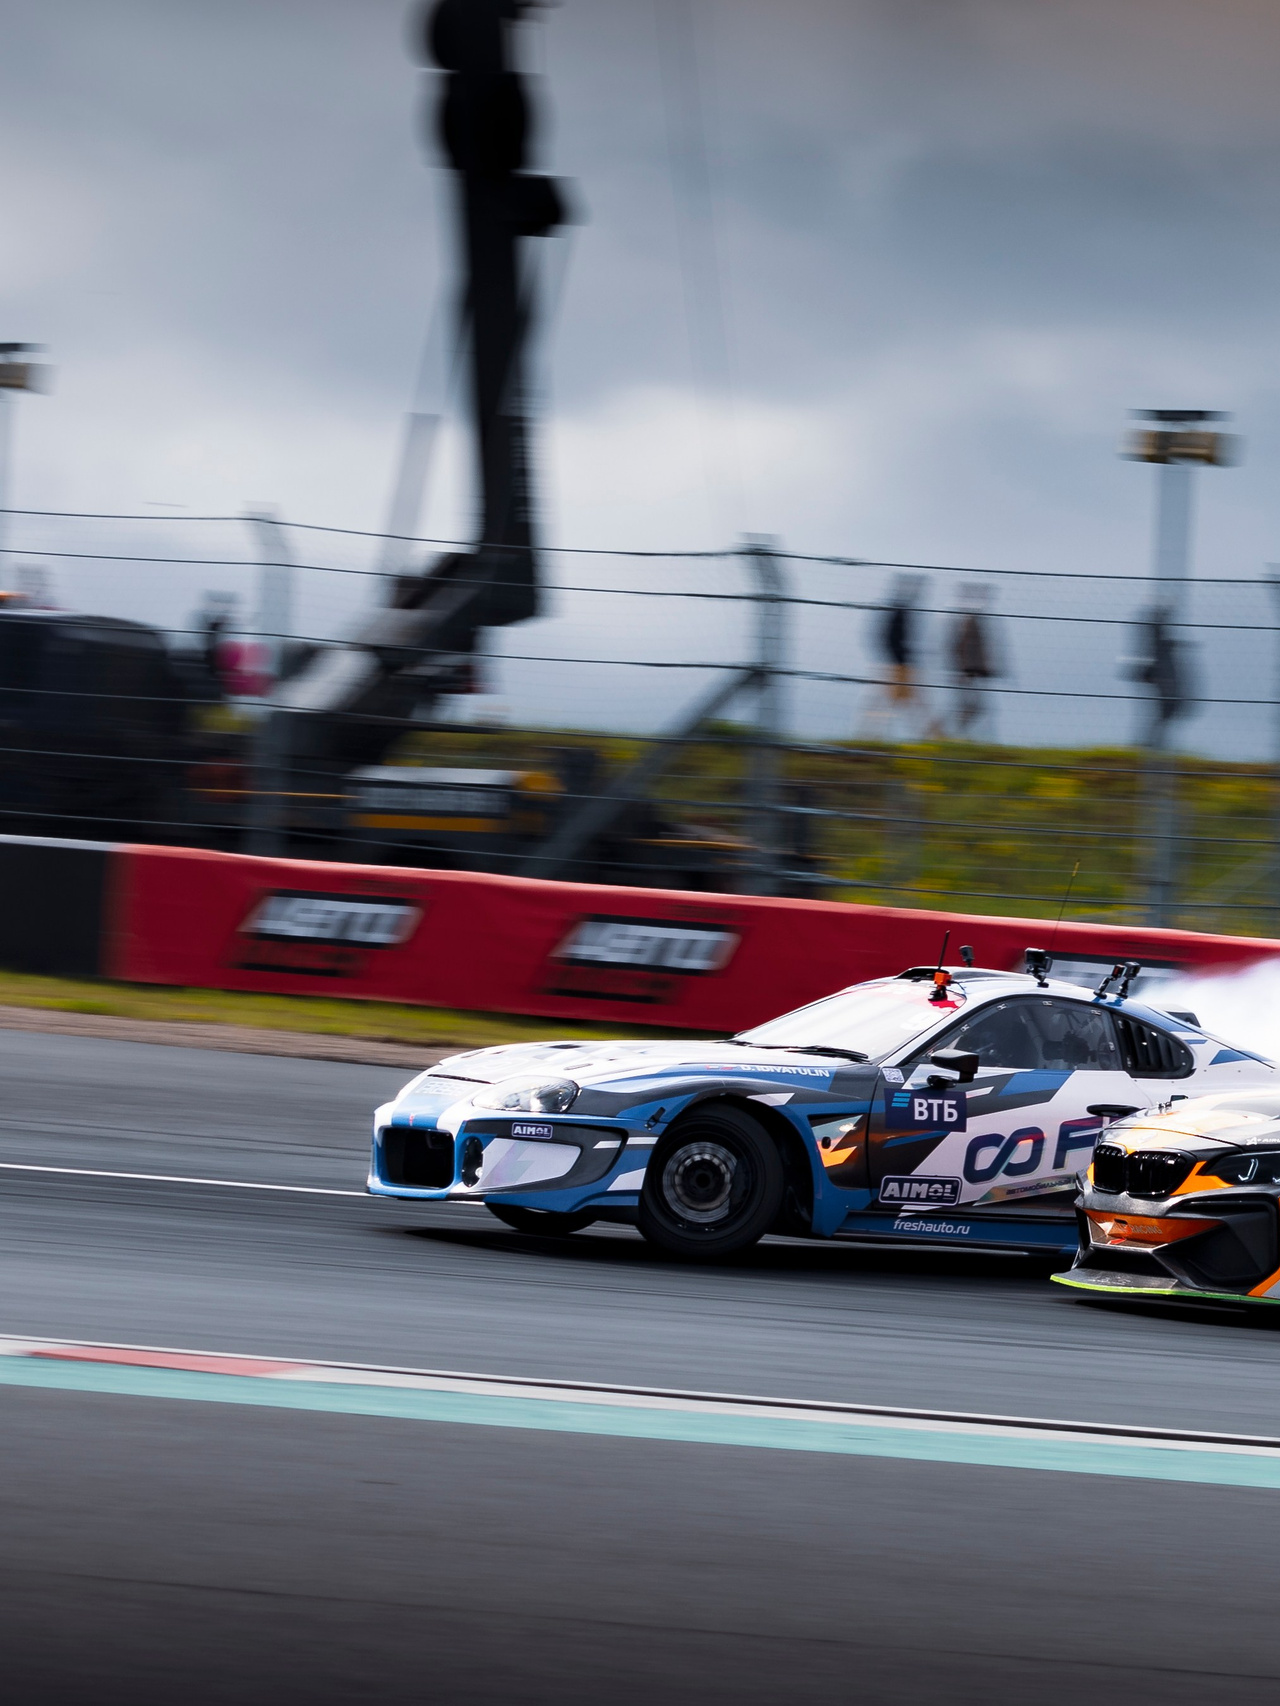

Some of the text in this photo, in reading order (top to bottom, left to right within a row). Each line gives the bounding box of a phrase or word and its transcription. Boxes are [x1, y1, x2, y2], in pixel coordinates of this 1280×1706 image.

[914, 1099, 959, 1122] ВТБ
[513, 1125, 551, 1137] AIMOL
[883, 1182, 955, 1201] AIMOL
[893, 1219, 970, 1234] freshauto.ru
